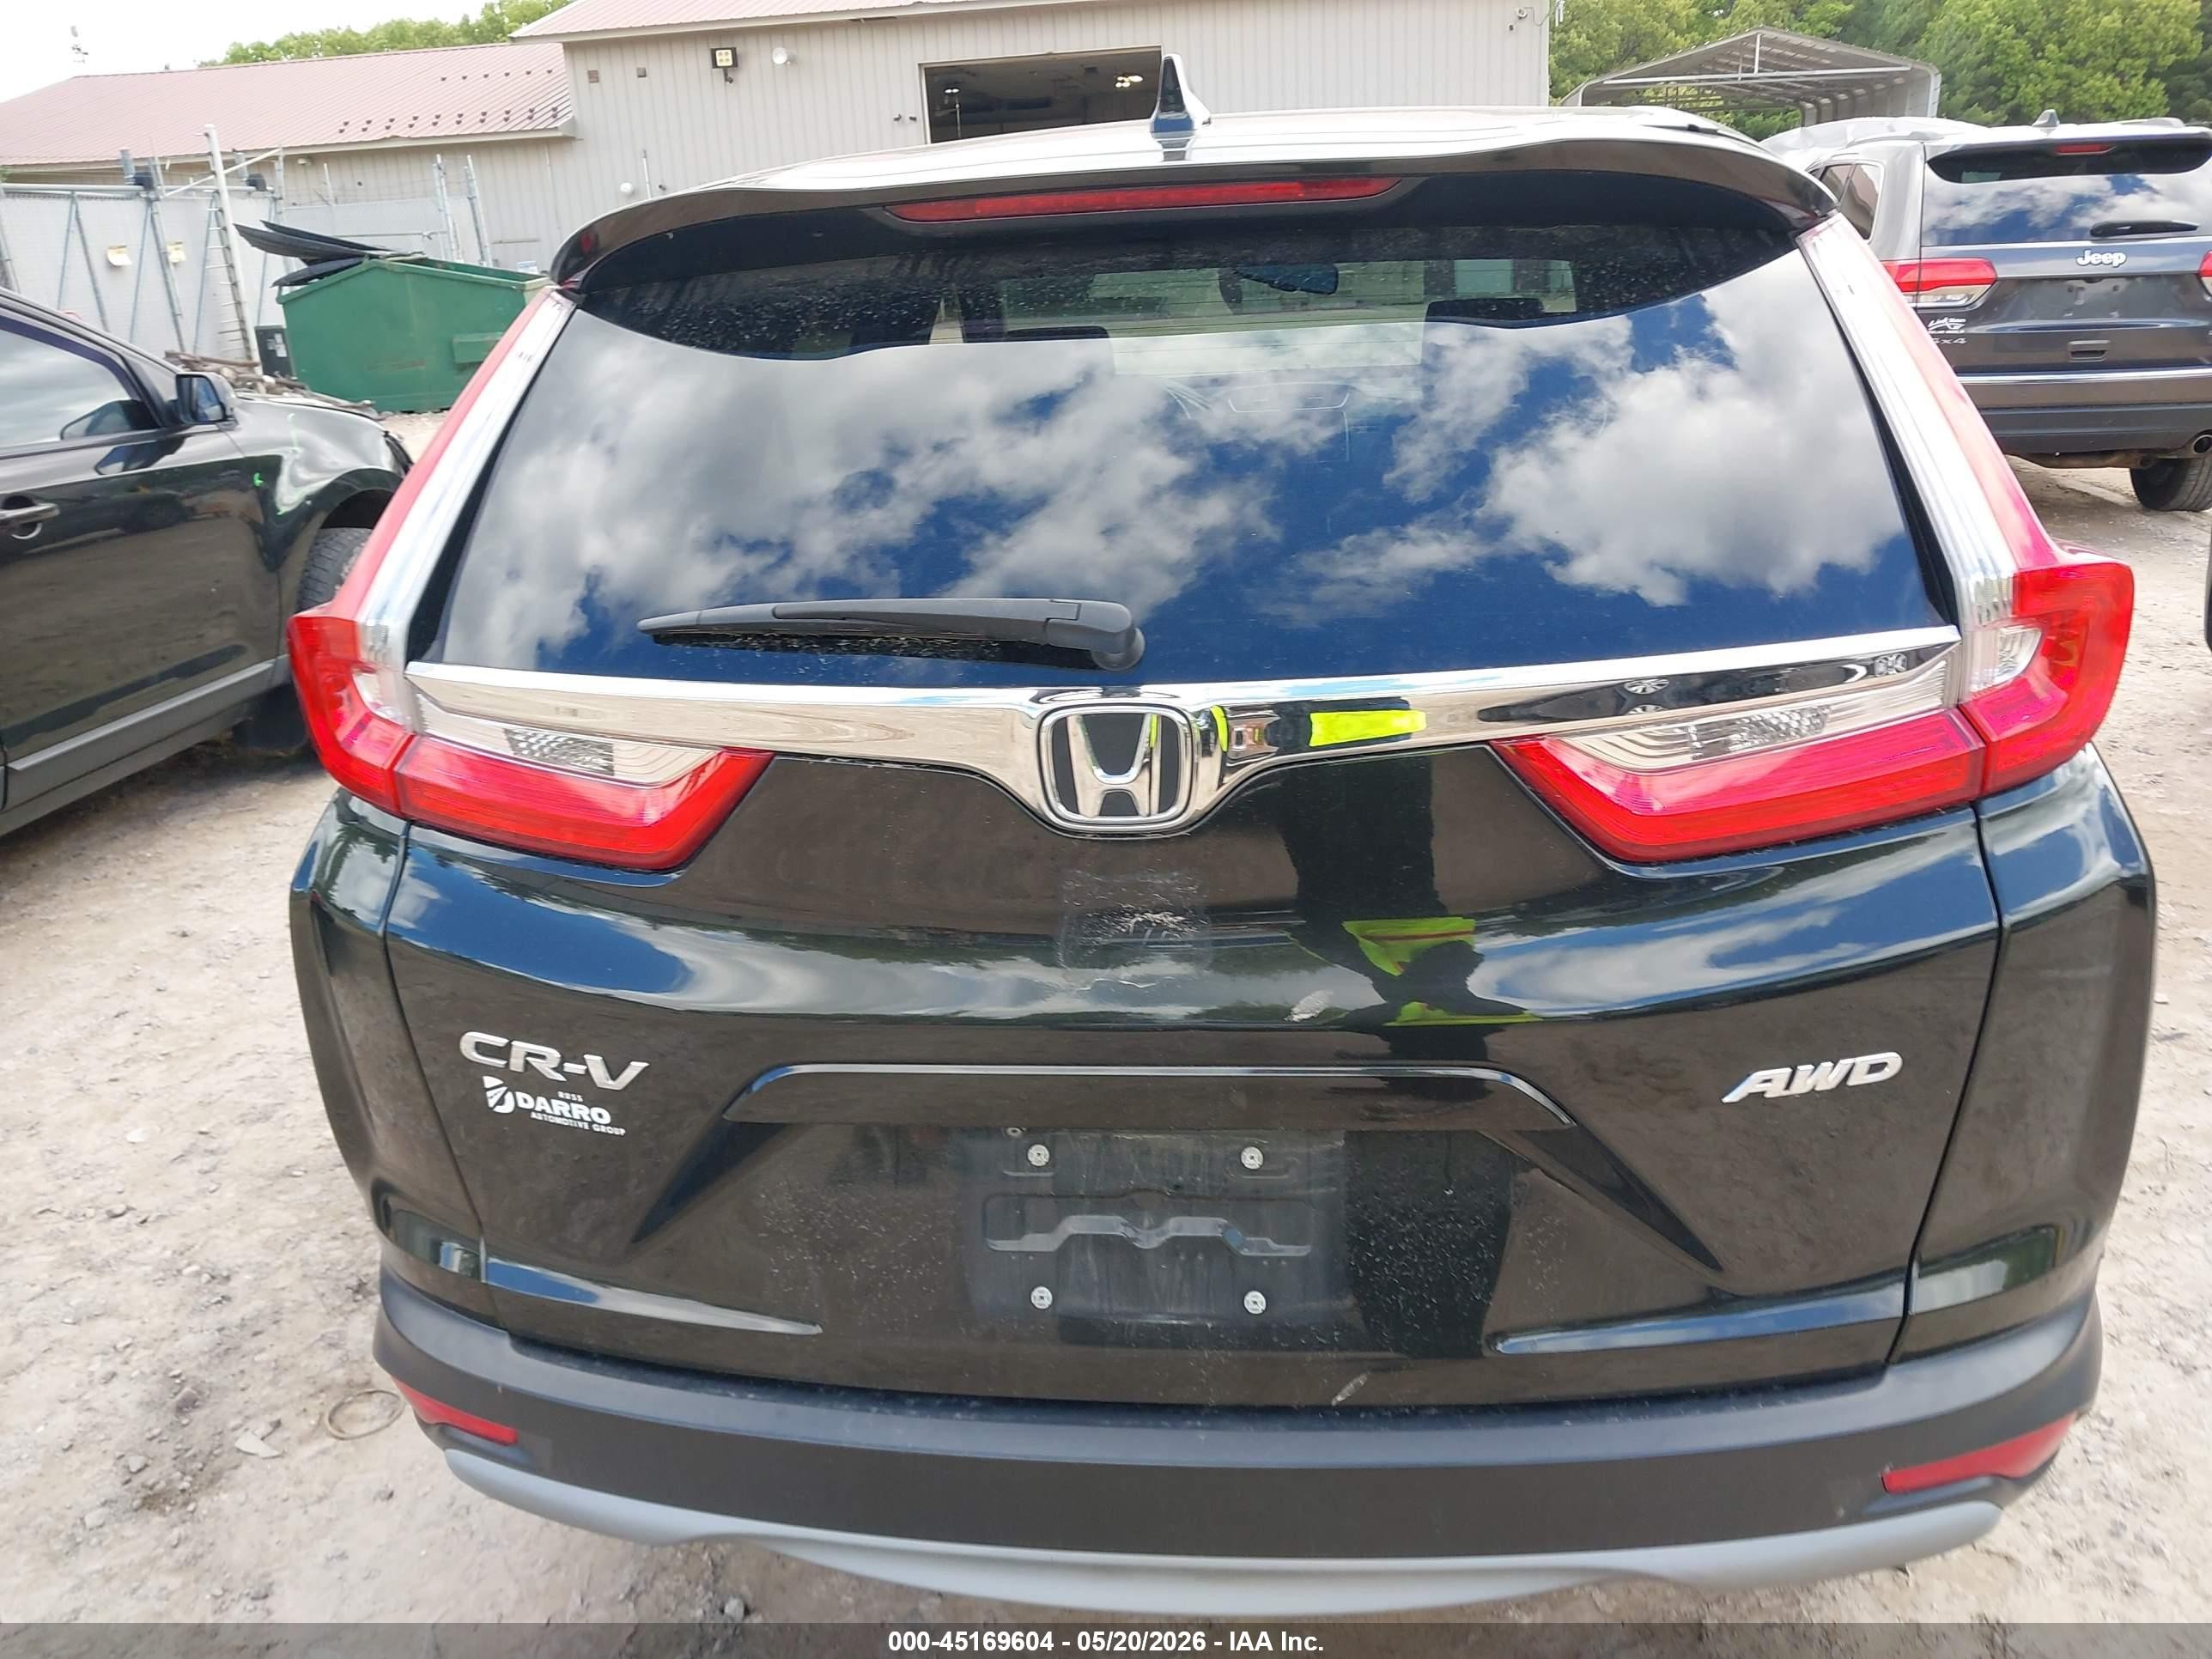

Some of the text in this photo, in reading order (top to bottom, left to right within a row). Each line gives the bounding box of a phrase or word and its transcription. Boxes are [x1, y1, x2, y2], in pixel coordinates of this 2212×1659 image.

[2076, 249, 2126, 267] Jeep
[459, 1031, 650, 1091] CR-V
[1721, 1052, 1903, 1103] AWD
[515, 1091, 611, 1125] DARRO
[530, 1111, 627, 1136] AUTOMOTIVE GROUP
